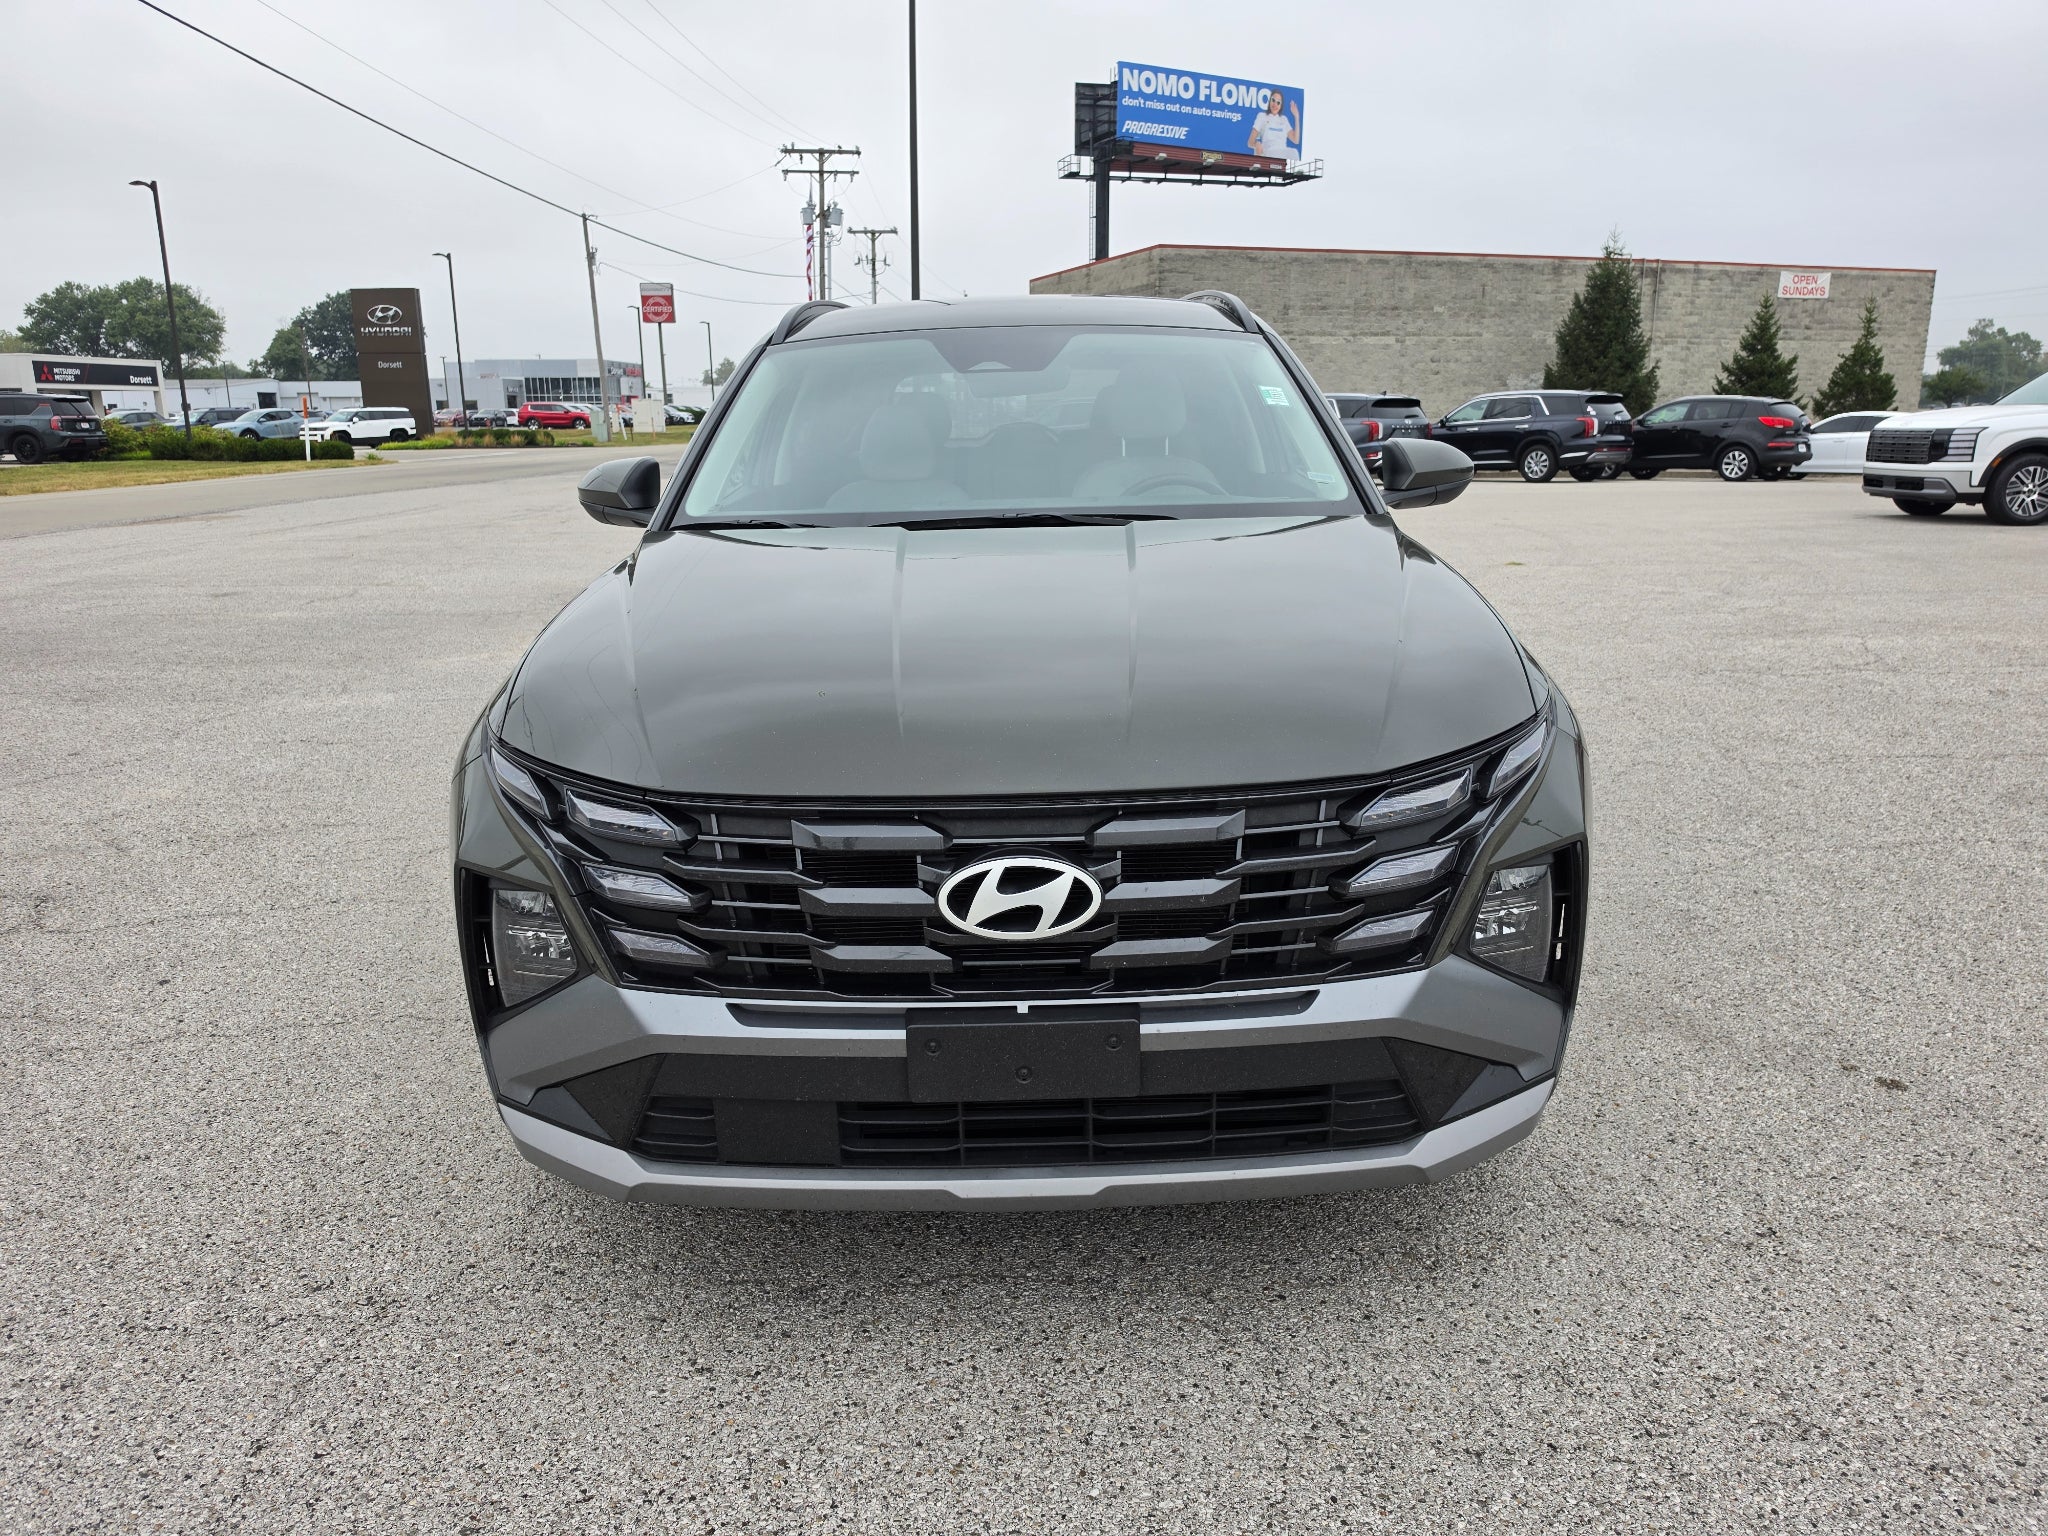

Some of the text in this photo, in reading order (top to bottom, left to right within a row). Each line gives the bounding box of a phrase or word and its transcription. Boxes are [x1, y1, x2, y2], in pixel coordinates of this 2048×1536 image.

[1122, 68, 1273, 110] NOMO FLOMO
[1122, 96, 1242, 122] don't miss out on auto savings
[1122, 120, 1190, 140] PROGRESSIVE
[1792, 274, 1819, 284] OPEN
[1781, 285, 1826, 296] SUNDAYS
[360, 326, 412, 336] HYUNDAI
[377, 360, 402, 369] Dorsett
[129, 375, 153, 384] Dorsett
